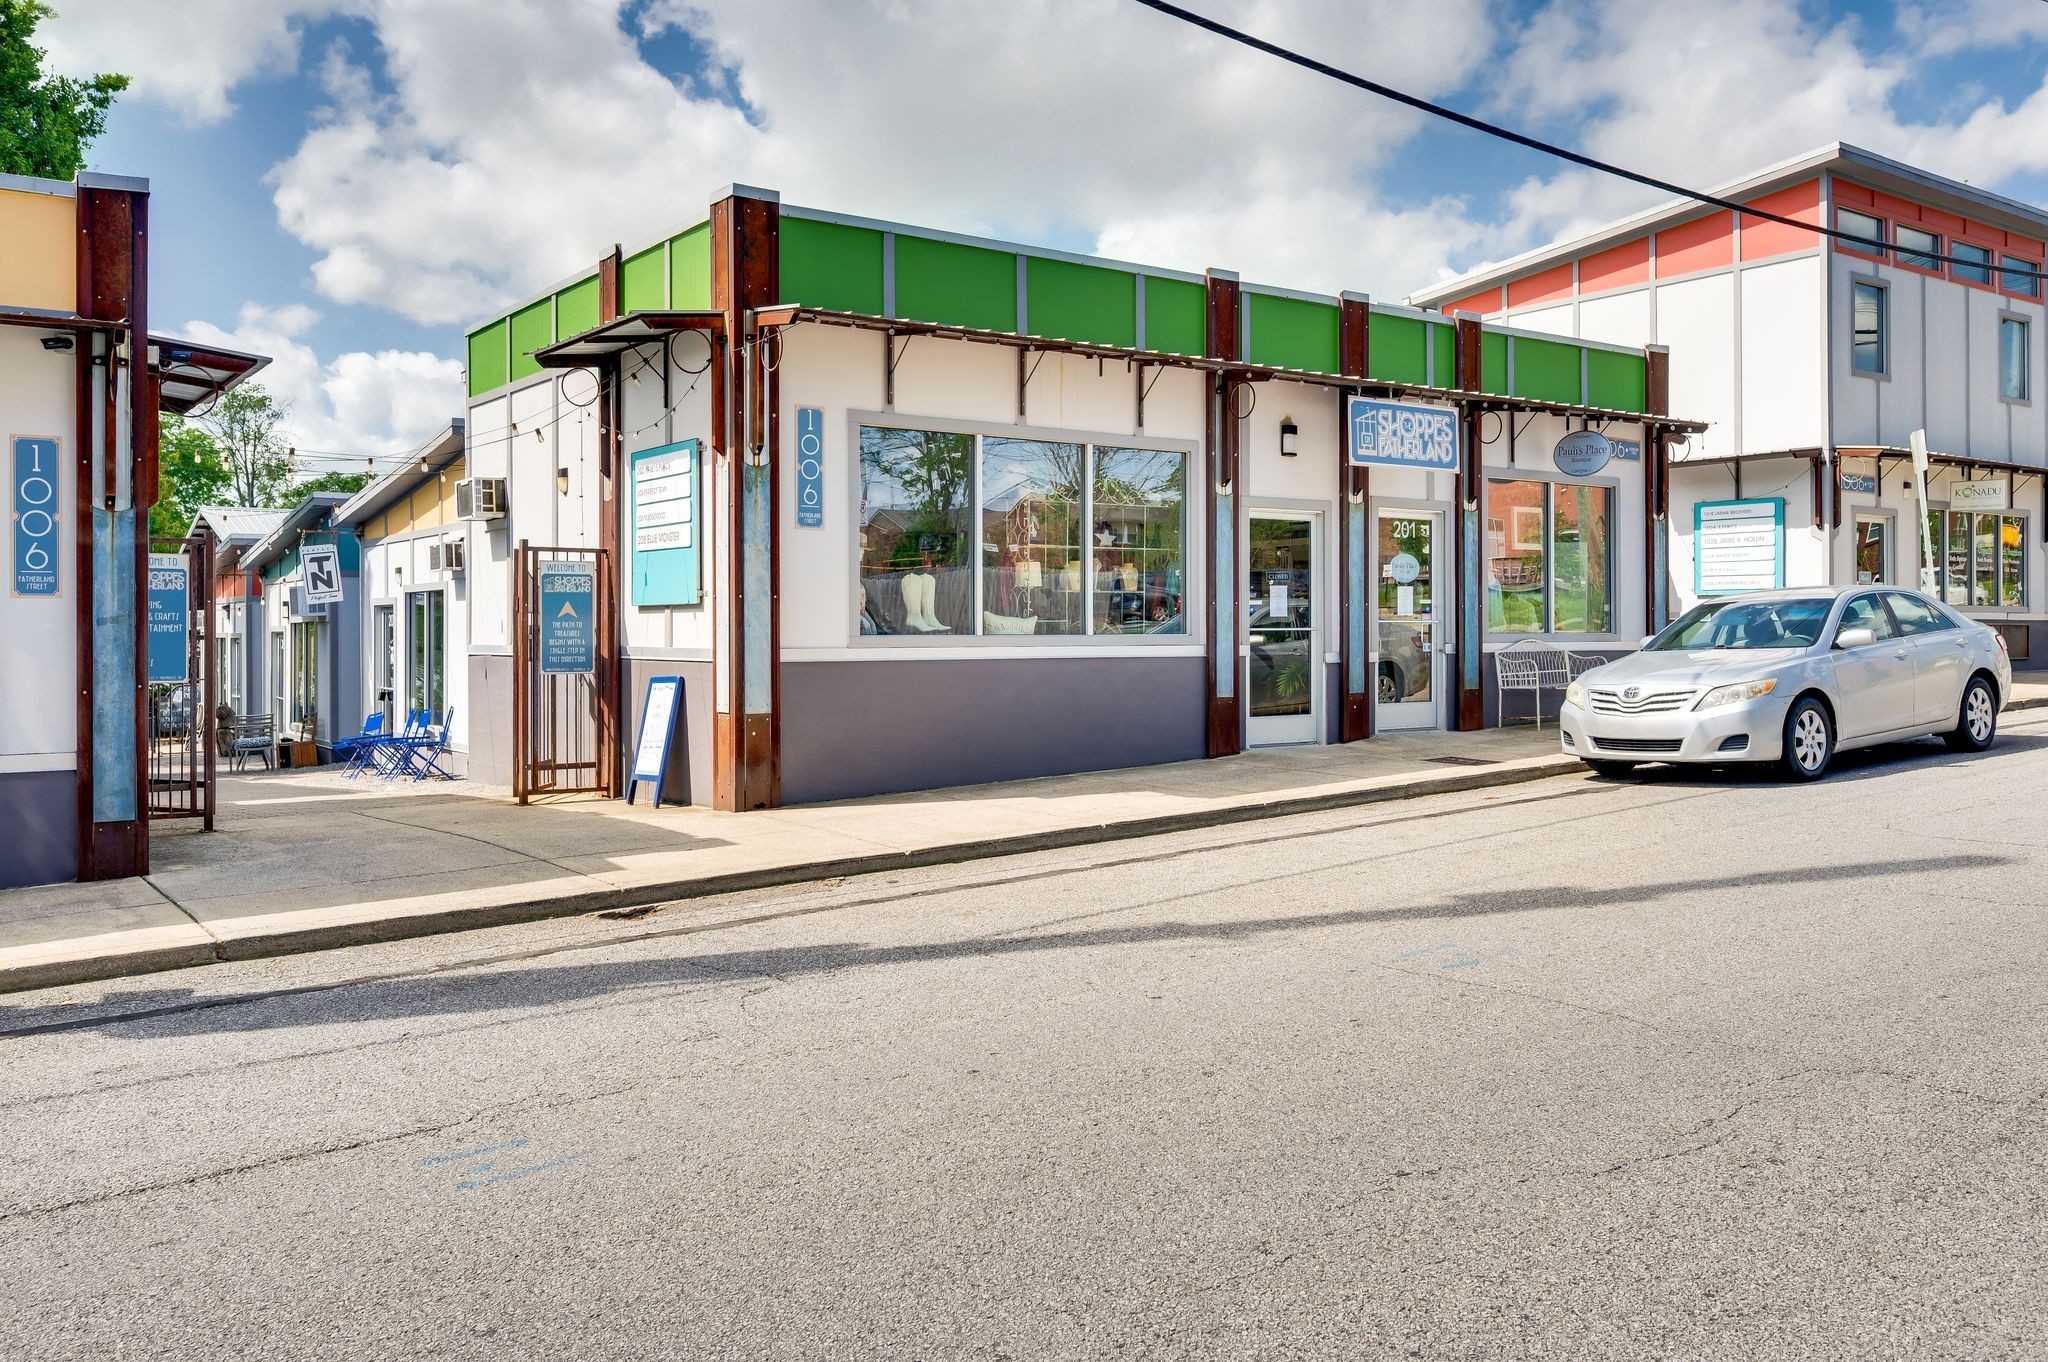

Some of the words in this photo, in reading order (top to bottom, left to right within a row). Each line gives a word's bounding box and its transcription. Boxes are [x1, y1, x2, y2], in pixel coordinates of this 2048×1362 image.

[1378, 409, 1453, 443] SHOPPES
[1378, 435, 1453, 464] FATHERLAND
[1558, 446, 1583, 456] Pauli's
[1586, 445, 1607, 455] Place
[801, 409, 820, 504] 1006
[1955, 487, 2001, 498] KONADU
[20, 444, 52, 570] 1006
[1393, 521, 1416, 538] 201
[167, 557, 178, 566] TO
[547, 563, 575, 572] WELCOME
[578, 564, 586, 572] TO
[18, 575, 55, 583] FATHERLAND
[554, 576, 591, 586] SHOPPES
[155, 612, 179, 621] CRAFTS
